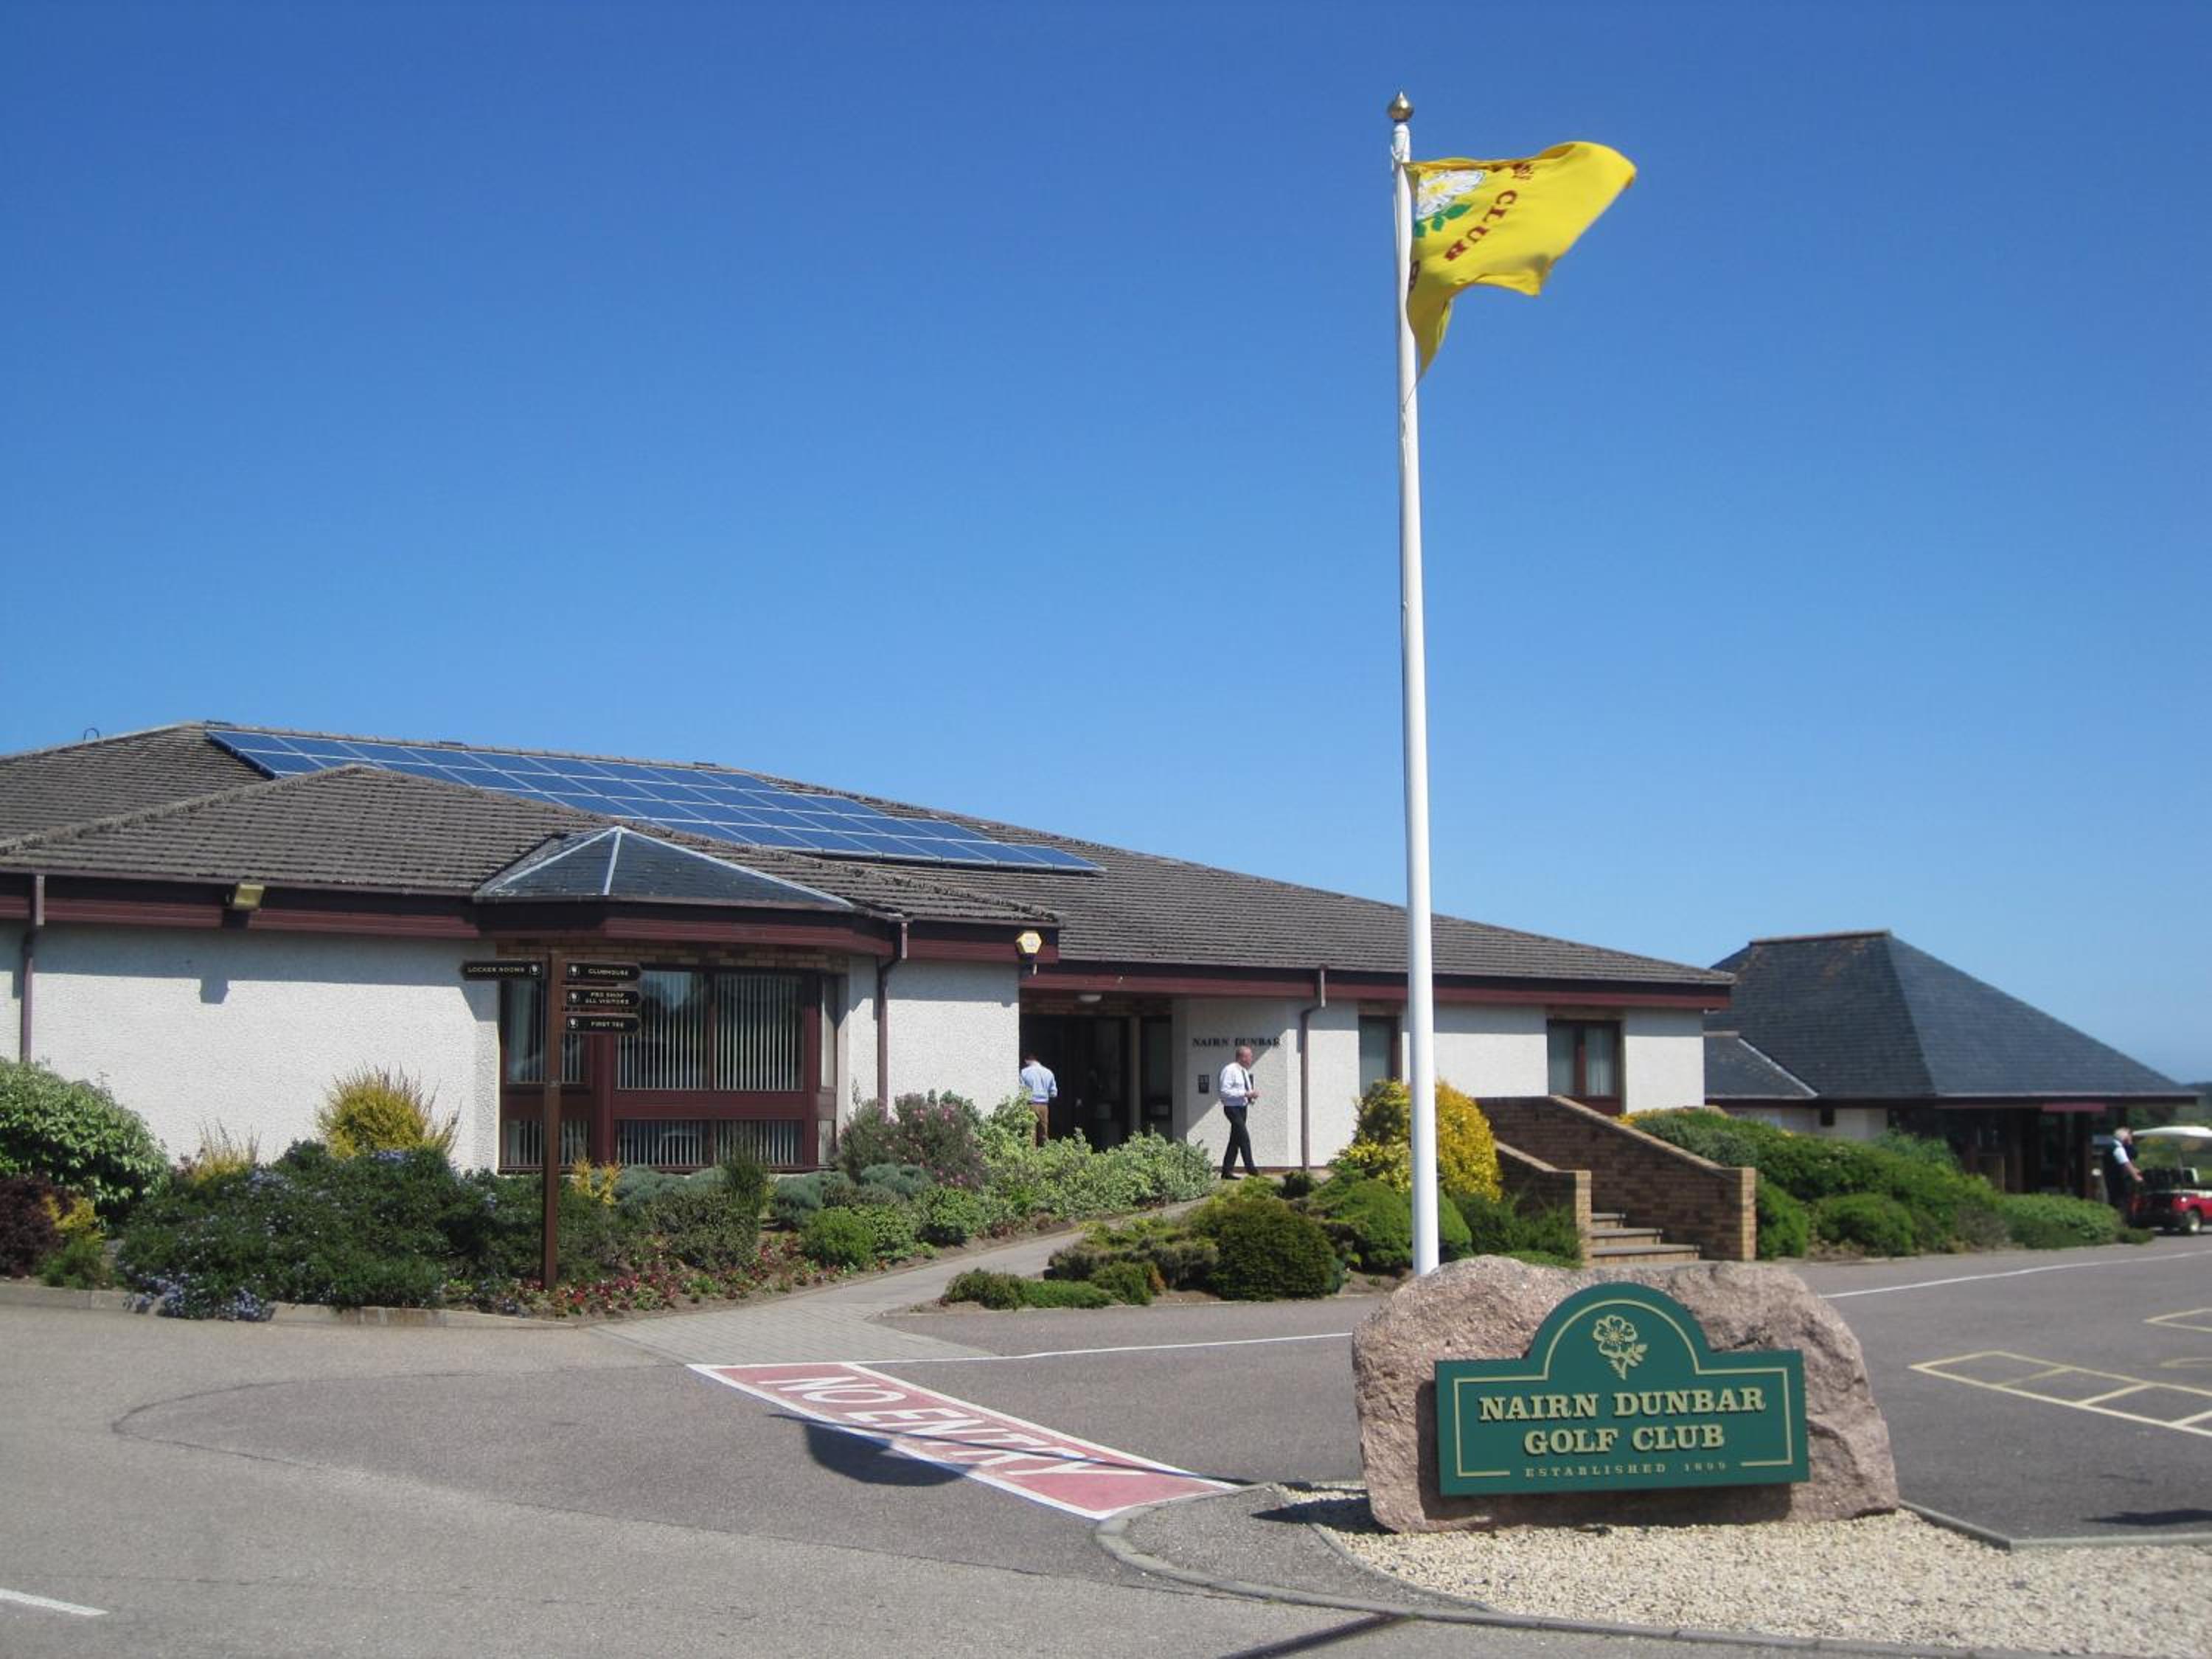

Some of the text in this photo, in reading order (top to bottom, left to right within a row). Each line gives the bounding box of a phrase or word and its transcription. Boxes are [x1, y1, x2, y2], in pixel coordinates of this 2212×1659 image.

[1443, 189, 1518, 261] CLUB
[1192, 1037, 1281, 1047] NAIRN DUNBAR
[1478, 1386, 1767, 1421] NAIRN DUNBAR
[757, 1376, 1147, 1475] NO ENTRY
[1523, 1423, 1725, 1455] GOLF CLUB
[1525, 1463, 1666, 1478] ESTABLISHED
